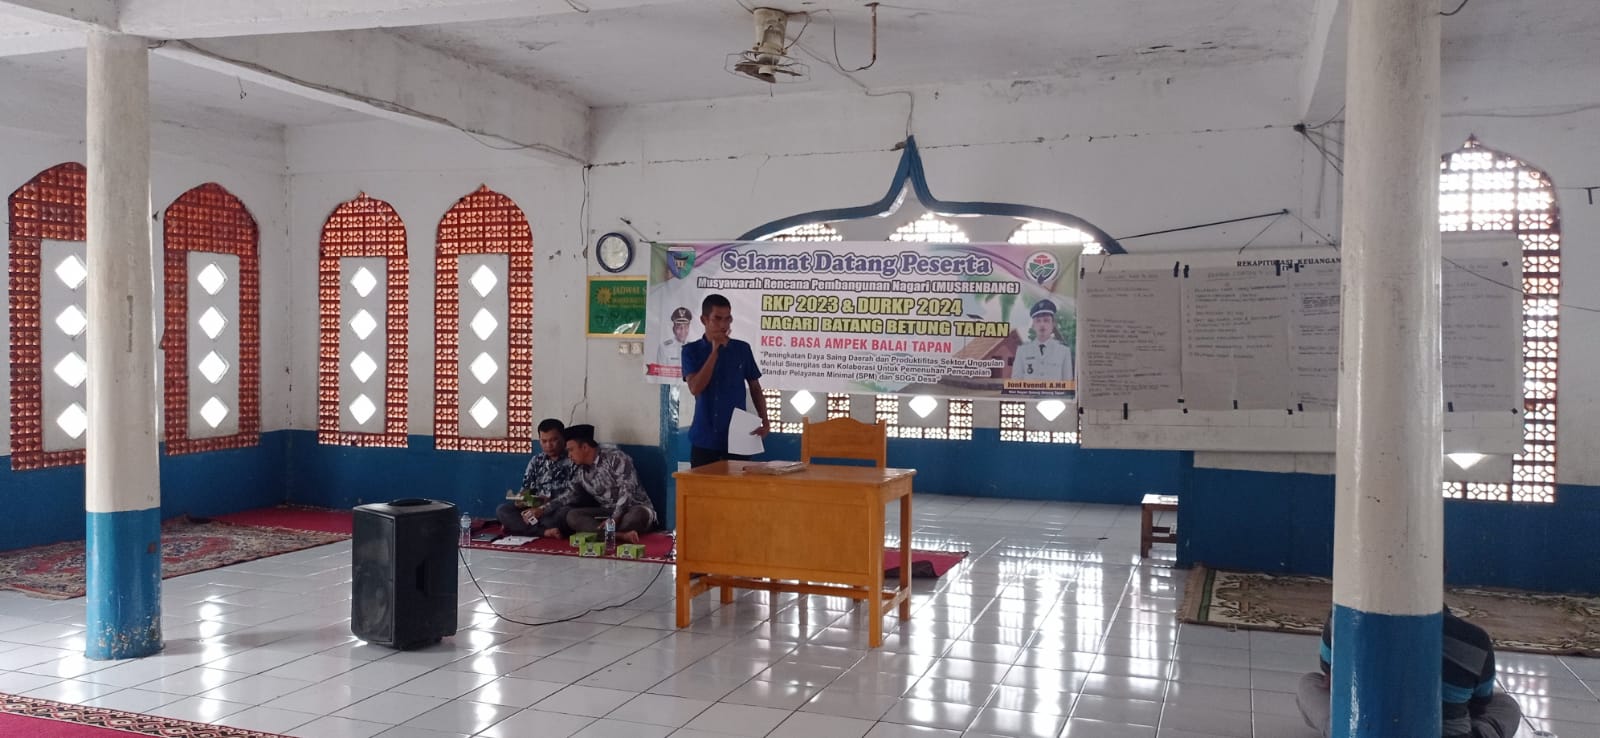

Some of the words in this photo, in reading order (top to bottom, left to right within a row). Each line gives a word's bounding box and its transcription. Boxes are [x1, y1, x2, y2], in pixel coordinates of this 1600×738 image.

[722, 250, 812, 272] Selamat
[812, 250, 898, 277] Datang
[901, 251, 991, 275] Peserta
[1236, 260, 1293, 268] REKAPITUASI
[697, 277, 762, 290] Musyawarah
[763, 279, 811, 290] Rencana
[811, 280, 890, 292] Pembangunan
[892, 281, 930, 293] Nagari
[931, 281, 1020, 294] (MUSRENBANG)
[762, 295, 794, 312] RKP
[796, 296, 839, 313] 2023
[841, 298, 855, 314] &
[857, 297, 915, 315] DURKP
[917, 298, 963, 316] 2024
[761, 315, 819, 331] NAGARI
[820, 317, 883, 334] BATANG
[885, 319, 952, 336] BETUNG
[954, 321, 1009, 337] TAPAN
[761, 335, 786, 347] KEC.
[790, 336, 821, 348] BASA
[825, 338, 867, 350] AMPEK
[871, 339, 907, 351] BALAI
[912, 341, 952, 353] TAPAN
[807, 352, 825, 361] Daya
[826, 353, 847, 362] Saing
[891, 356, 938, 365] Produktifitas
[941, 358, 965, 366] Sektor
[967, 360, 1004, 368] Unggulan
[761, 368, 788, 376] Standar
[789, 370, 825, 379] Pelayanan
[826, 371, 854, 379] Minimal
[855, 372, 877, 380] (SPM)
[785, 361, 820, 370] Sinergitas
[837, 363, 875, 371] Kolaborasi
[877, 364, 899, 372] Untuk
[901, 365, 945, 374] Pemenuhan
[947, 367, 991, 377] Pencapaian
